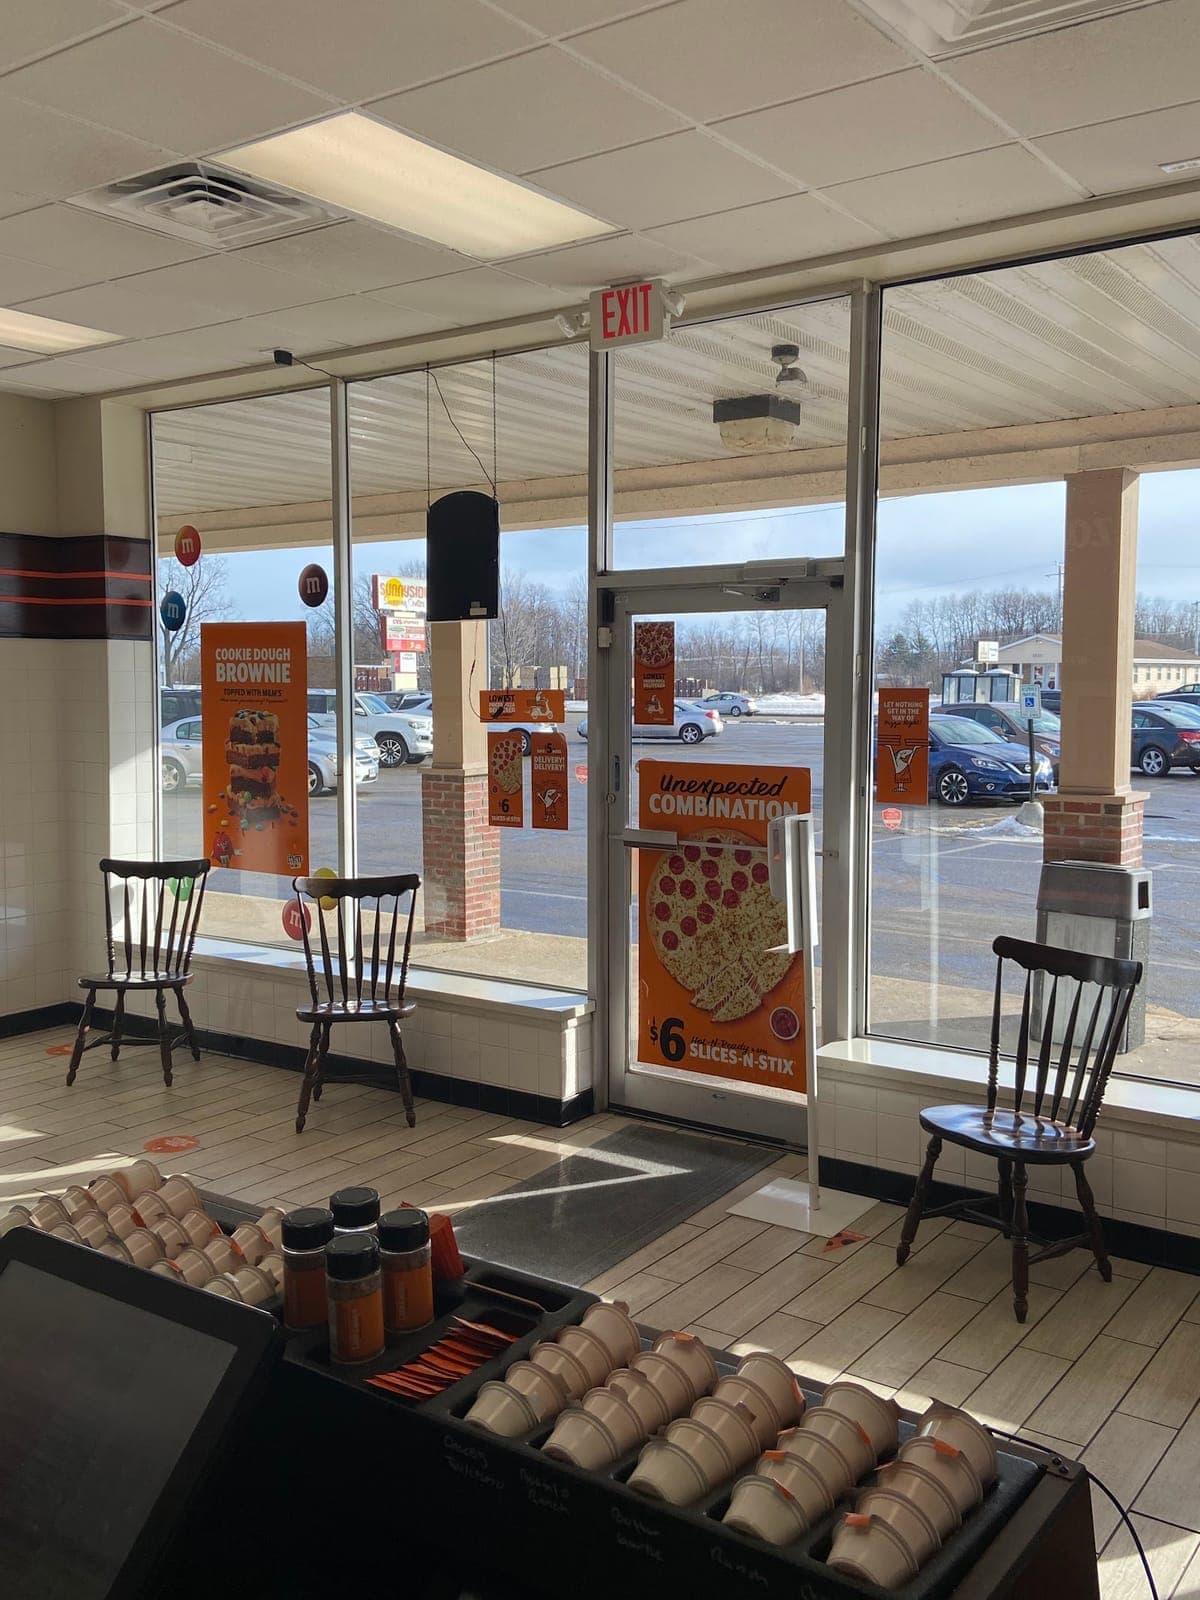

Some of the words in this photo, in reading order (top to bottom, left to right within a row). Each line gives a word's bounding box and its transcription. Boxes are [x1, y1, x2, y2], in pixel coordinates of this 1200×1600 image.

[602, 284, 652, 339] EXIT
[215, 647, 252, 661] COOKIE
[253, 647, 291, 661] DOUGH
[216, 662, 291, 684] BROWNIE
[246, 688, 260, 697] WITH
[489, 694, 515, 703] LOWEST
[895, 701, 924, 709] NOTHING
[534, 755, 565, 763] DELIVERY!
[534, 763, 565, 771] DELIVERY!
[660, 774, 788, 806] Unexpected
[649, 793, 799, 821] COMBINATION
[650, 1016, 686, 1062] $6
[689, 1042, 794, 1076] SLICES-N-STIX
